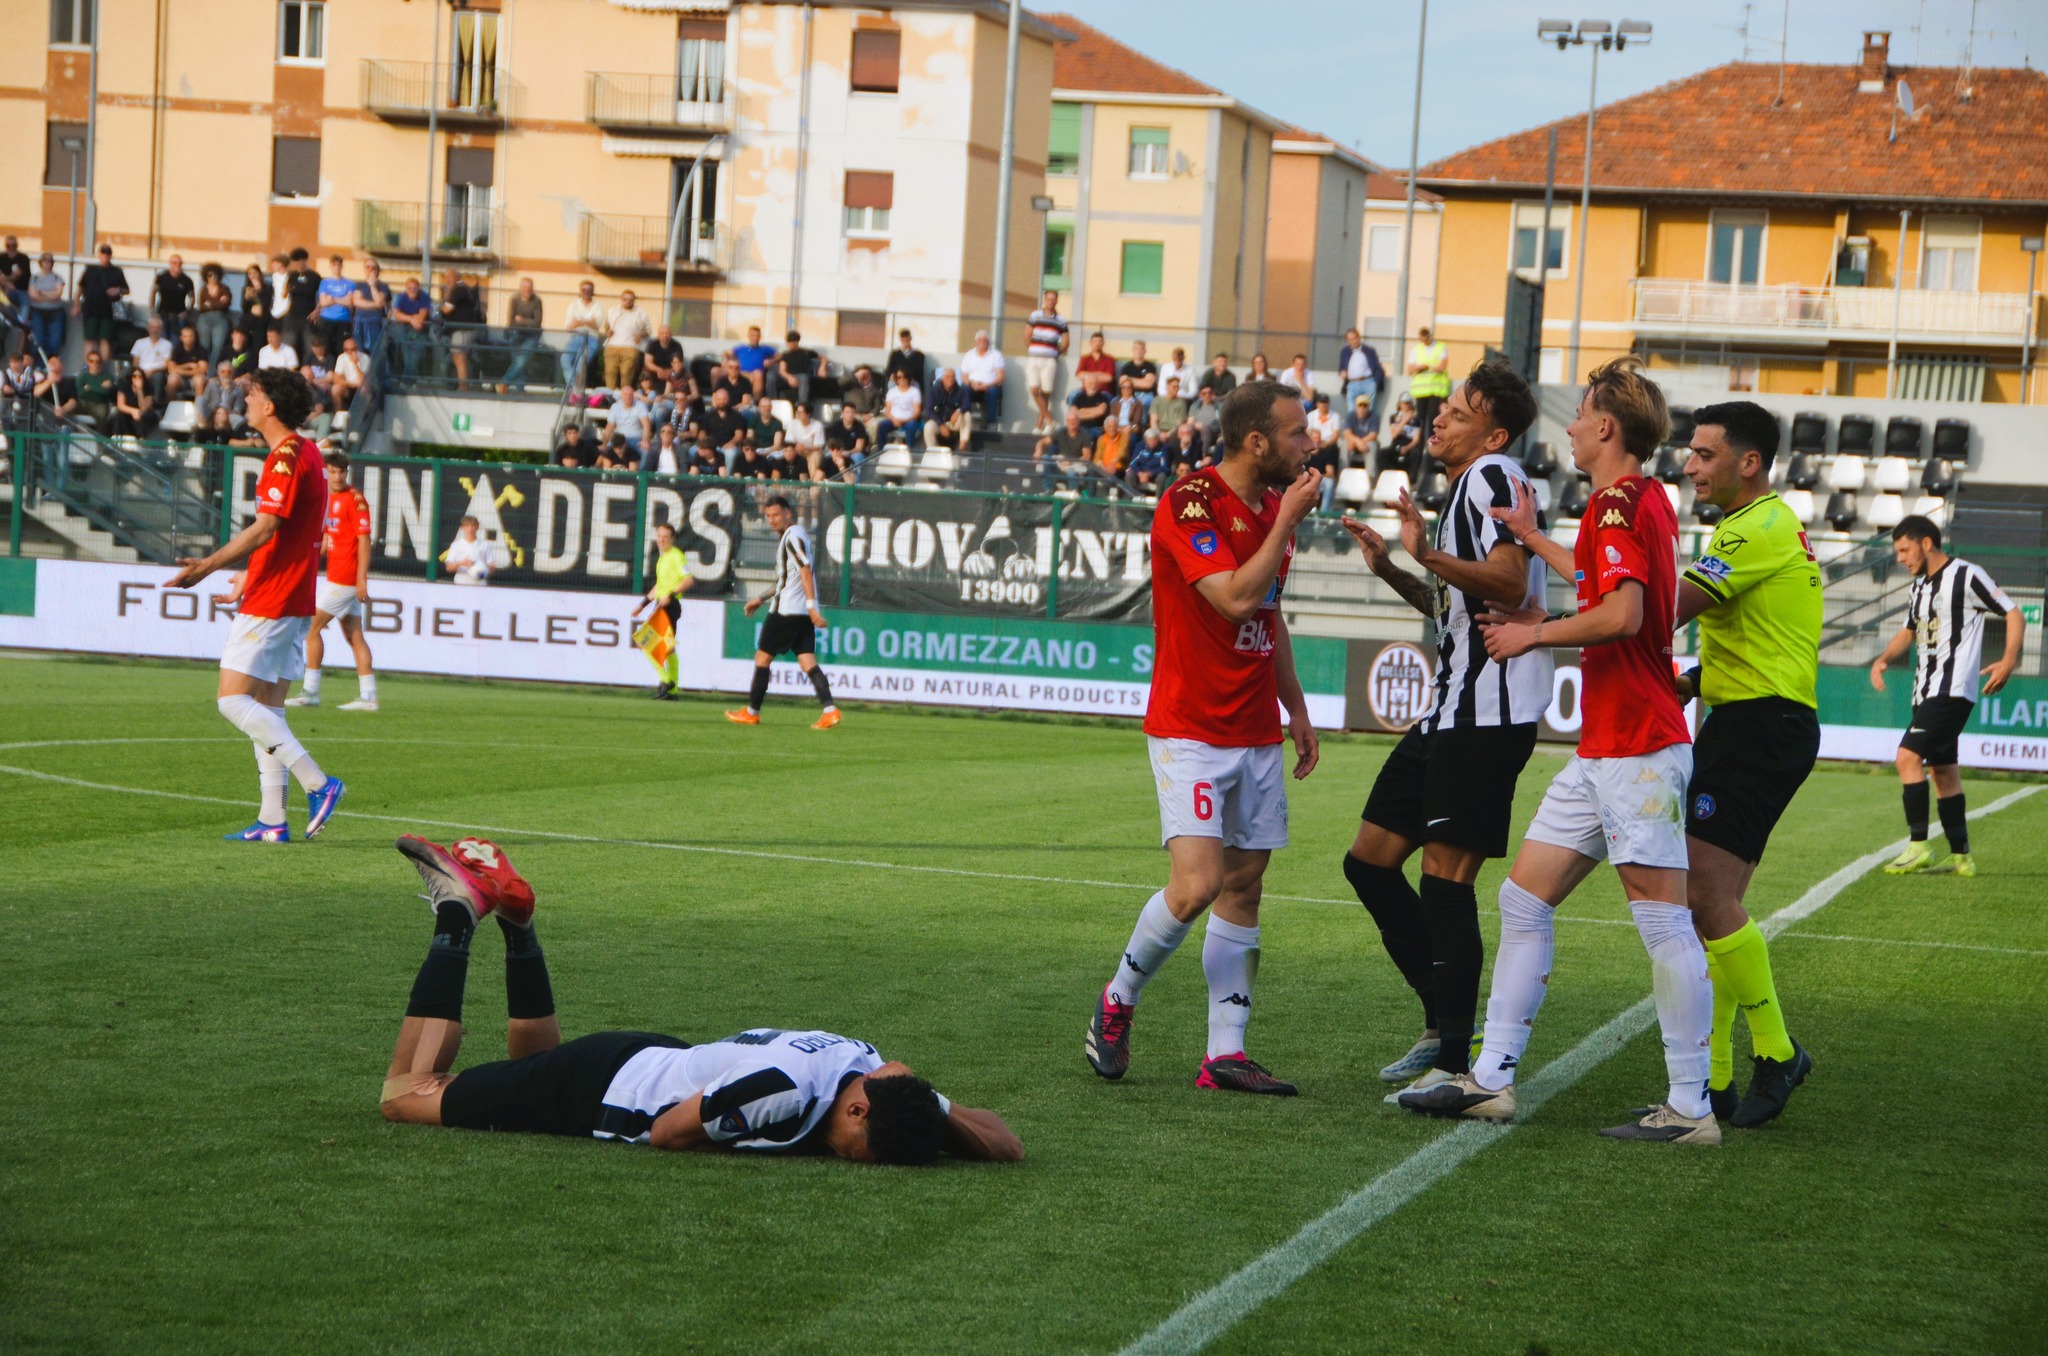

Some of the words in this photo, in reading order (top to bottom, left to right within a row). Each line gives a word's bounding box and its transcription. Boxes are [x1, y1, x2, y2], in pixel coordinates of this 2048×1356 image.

[961, 578, 1040, 605] 13900
[877, 629, 1097, 671] ORMEZZANO
[871, 675, 915, 692] AND
[924, 679, 1020, 699] NATURAL
[1029, 684, 1142, 706] PRODUCTS
[1193, 781, 1214, 821] 6
